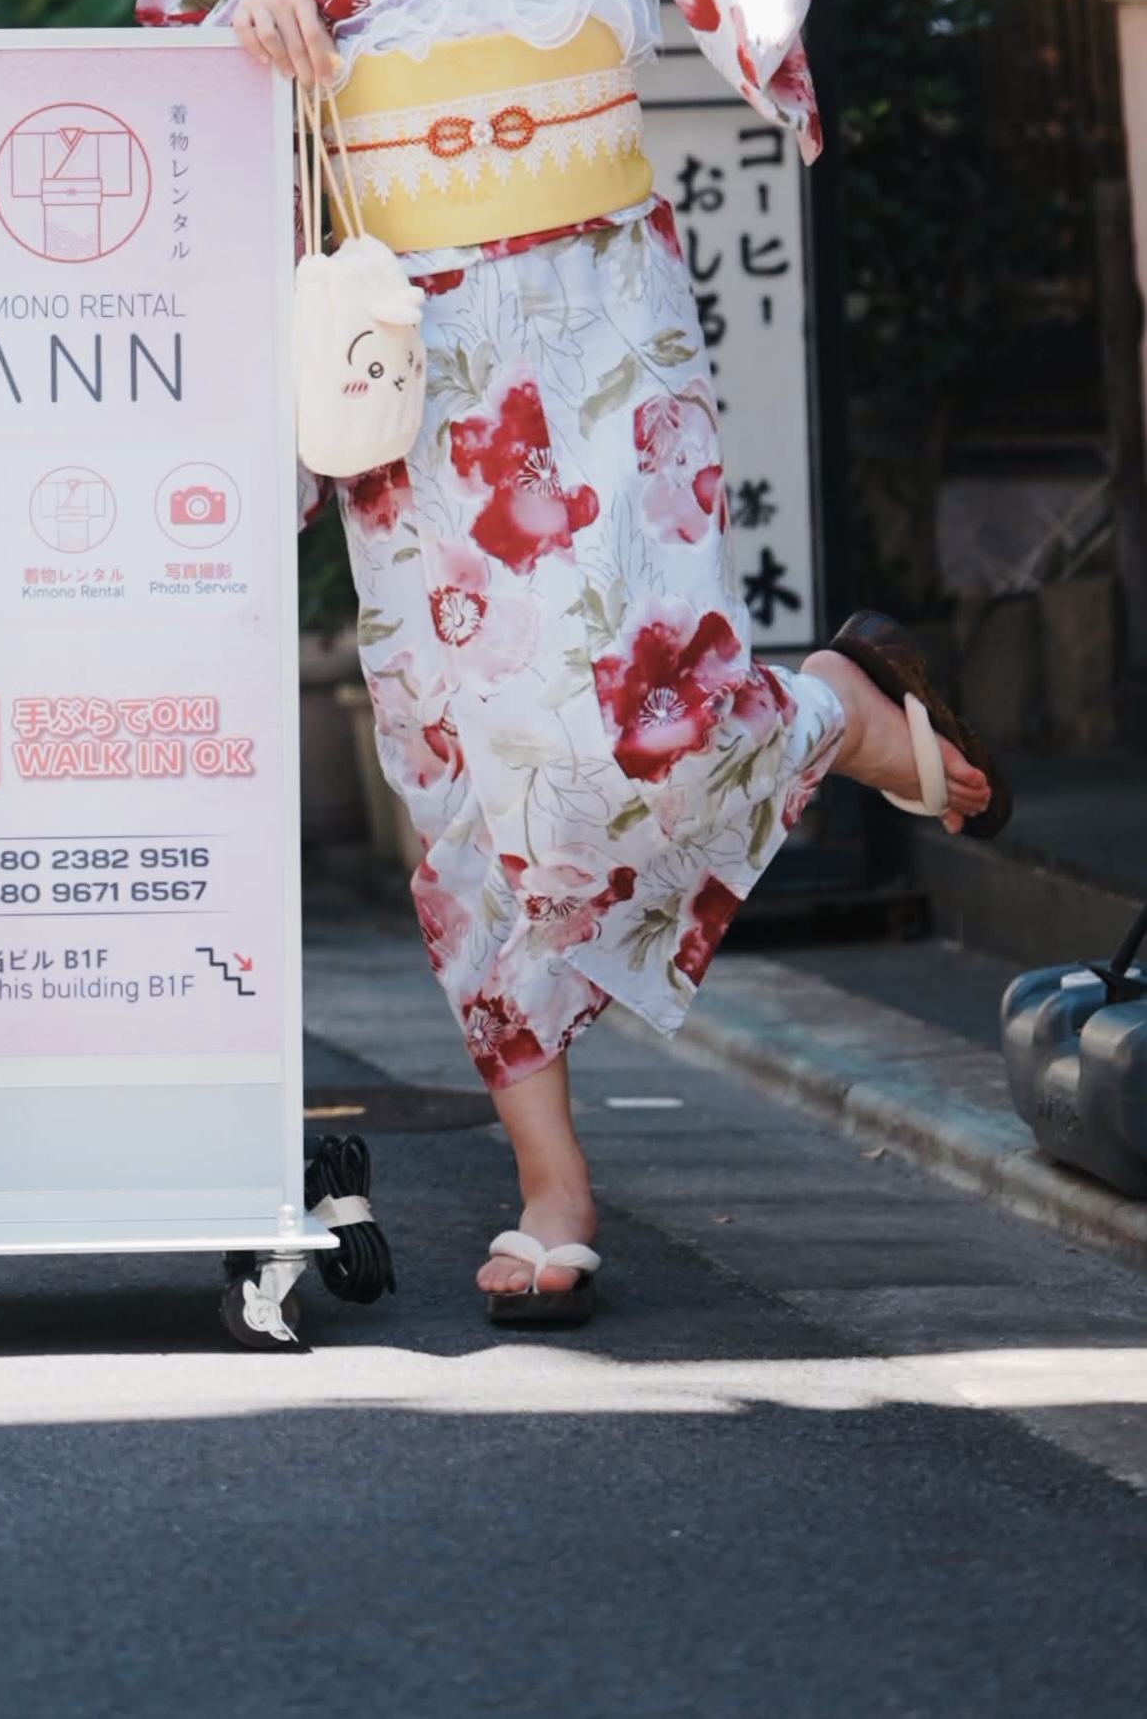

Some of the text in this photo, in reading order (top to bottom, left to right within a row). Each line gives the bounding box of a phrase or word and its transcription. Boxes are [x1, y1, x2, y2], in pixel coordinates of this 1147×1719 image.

[169, 103, 191, 260] 着物レンタル
[738, 127, 790, 325] コーヒー
[676, 154, 727, 414] おしる
[80, 292, 187, 319] RENTAL
[23, 567, 125, 584] 着物レンタル
[164, 562, 233, 580] 写真撮影
[21, 584, 125, 599] Kimono Rental
[149, 580, 248, 594] Photo Service
[13, 696, 218, 738] 手ぶらでOK!
[13, 737, 253, 777] WALK IN OK
[51, 849, 129, 870] 2382
[140, 847, 210, 868] 9516
[52, 882, 119, 903] 9671
[131, 880, 208, 902] 6567
[64, 948, 108, 970] B1F
[42, 976, 140, 1003] building
[149, 975, 195, 998] B1F
